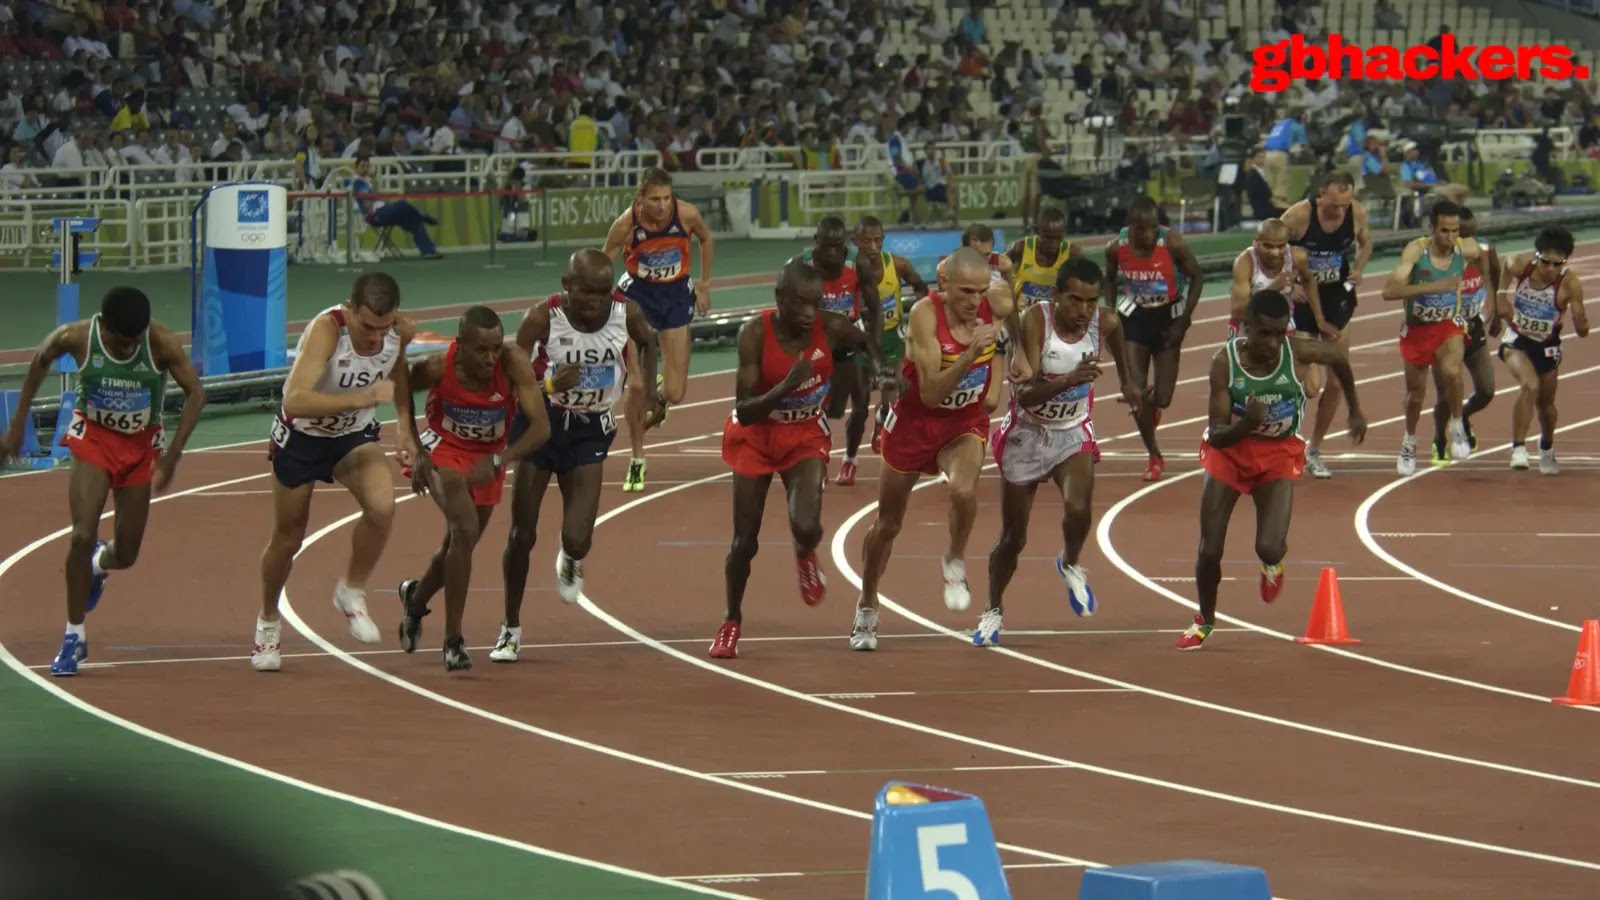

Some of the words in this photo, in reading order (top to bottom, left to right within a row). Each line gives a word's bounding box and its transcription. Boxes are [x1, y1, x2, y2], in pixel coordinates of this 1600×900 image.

[583, 193, 620, 225] 2004
[644, 265, 675, 279] 2571
[1123, 270, 1164, 281] KENYA
[566, 348, 615, 364] USA
[101, 376, 142, 389] ETHIOPIA
[559, 389, 605, 406] 3221
[1034, 401, 1079, 419] 2514
[71, 419, 84, 436] 4
[96, 411, 143, 430] 1665
[451, 421, 496, 439] 1554
[916, 822, 981, 900] 5
